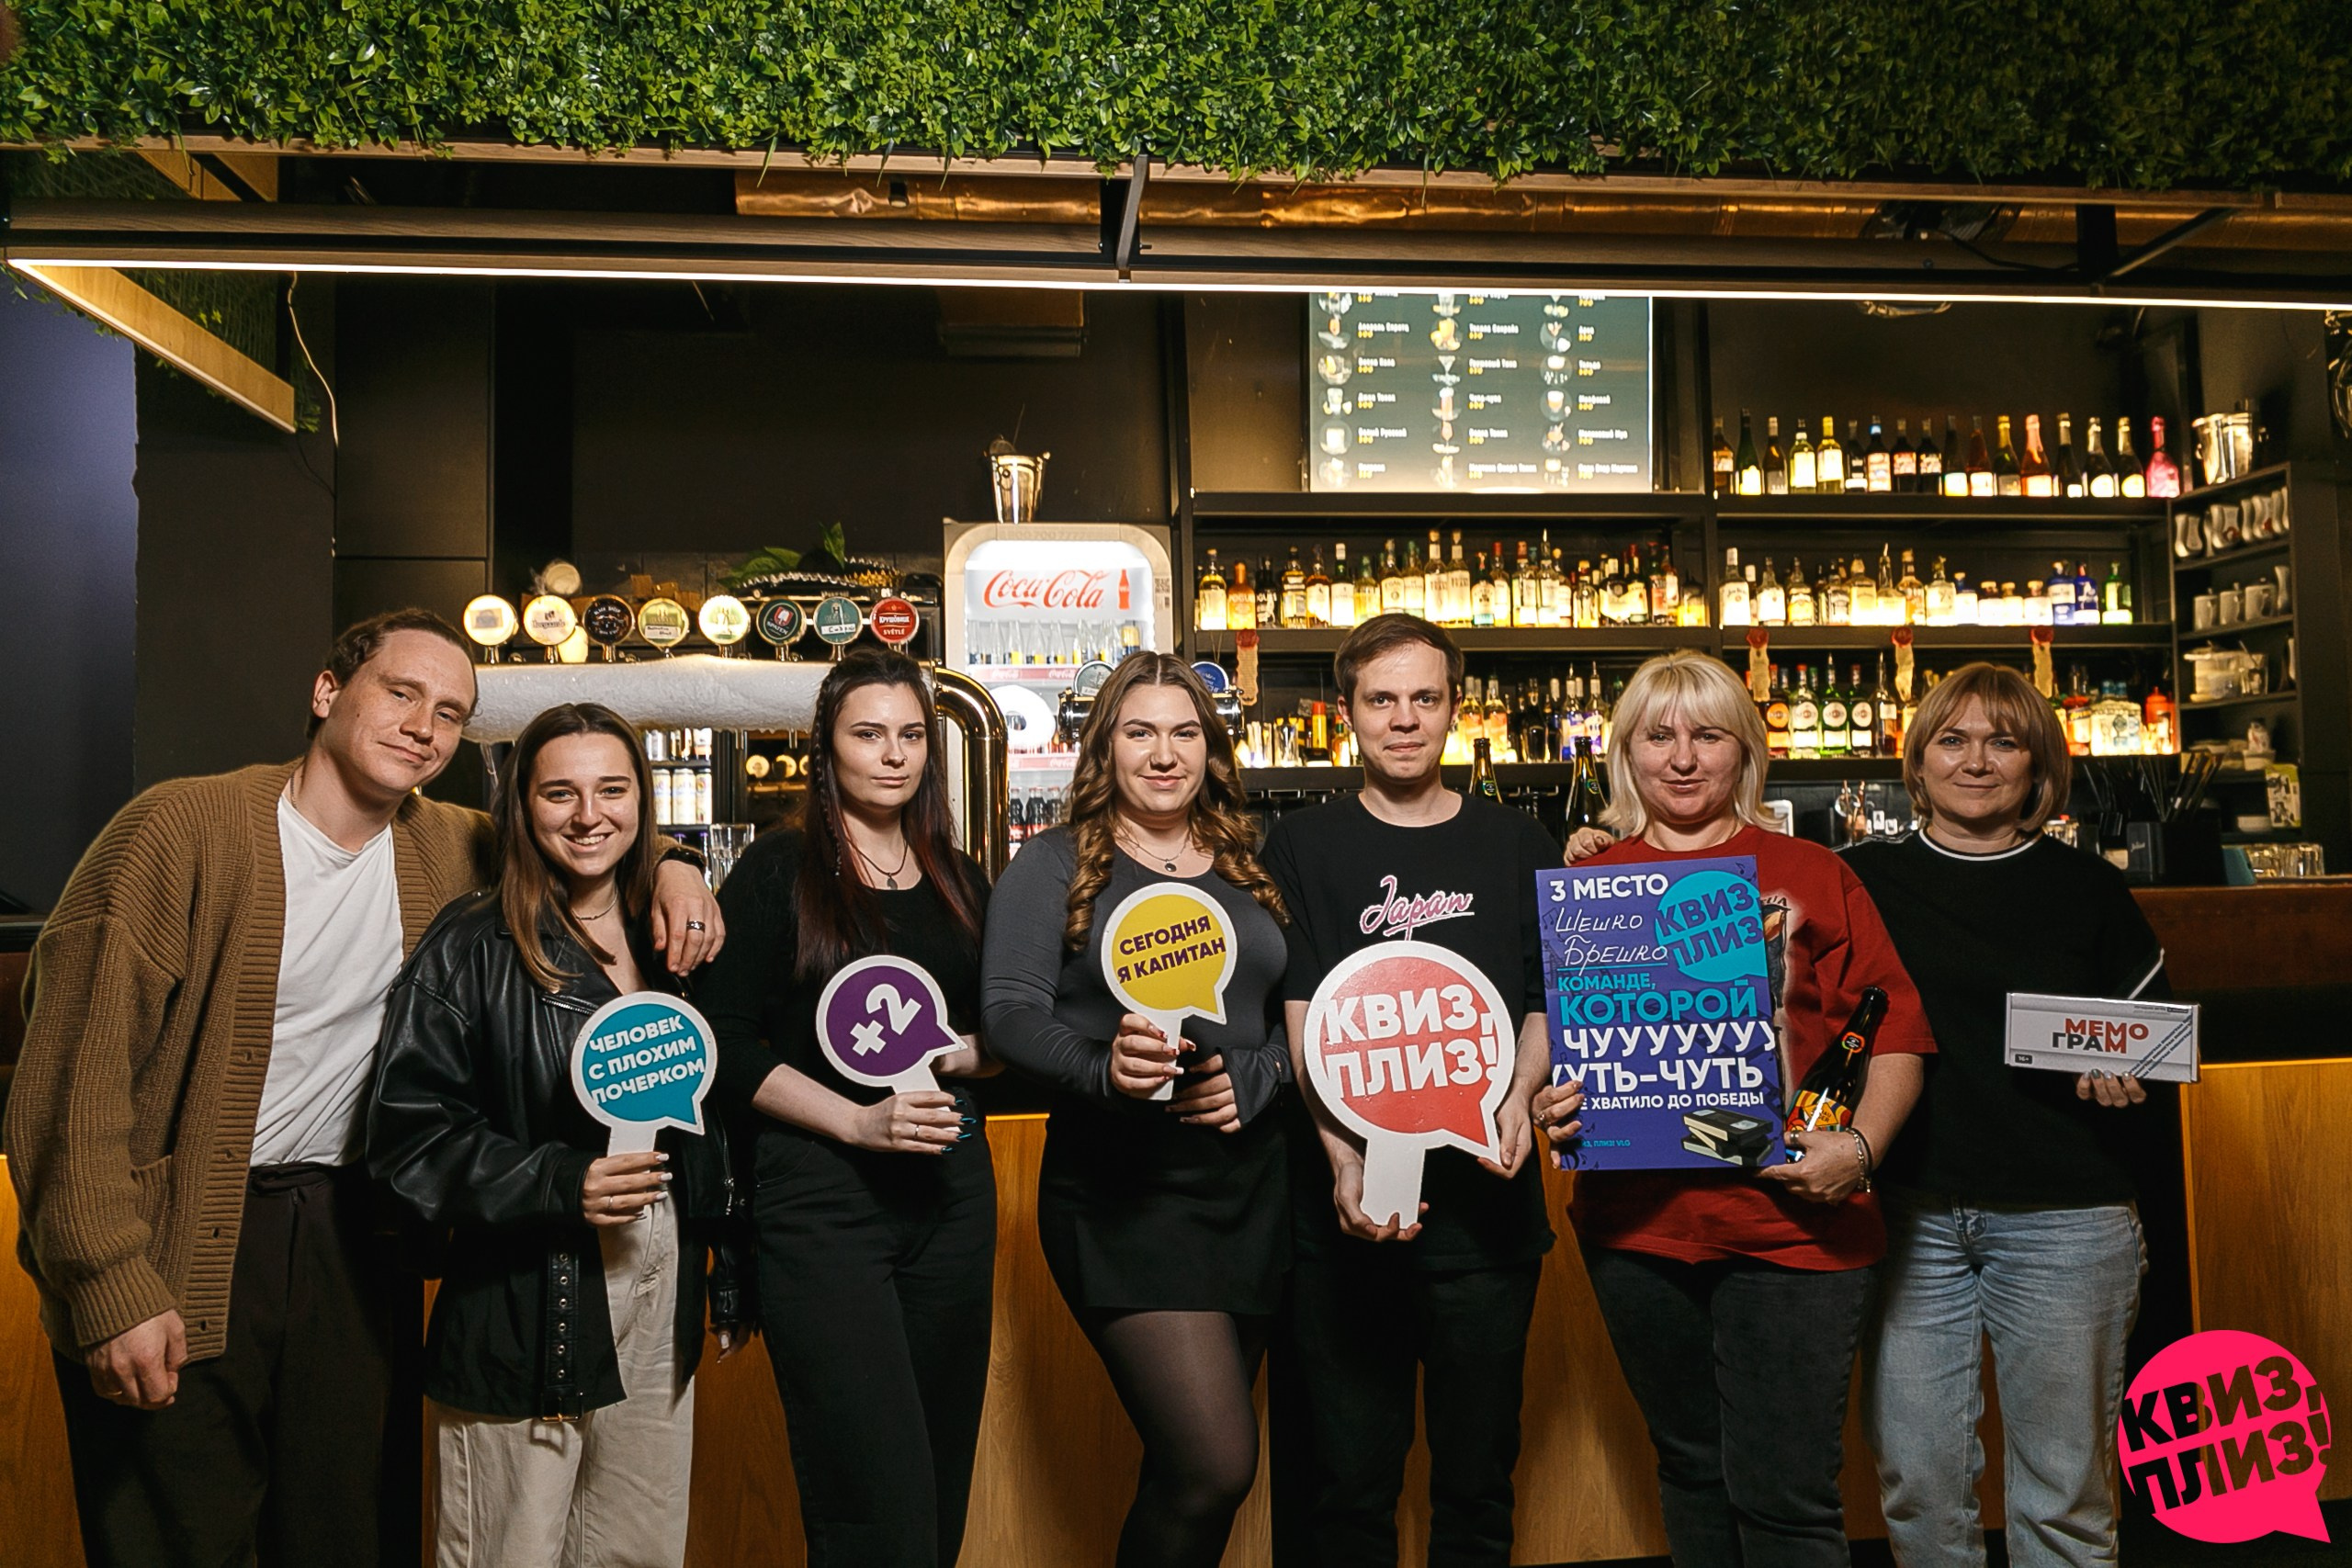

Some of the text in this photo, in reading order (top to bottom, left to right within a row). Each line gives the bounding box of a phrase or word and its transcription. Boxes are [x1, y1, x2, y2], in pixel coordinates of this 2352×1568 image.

[984, 570, 1110, 608] Coca-Cola
[1550, 873, 1669, 902] 3 МЕСТО
[1360, 874, 1475, 941] Japan
[1119, 915, 1212, 955] СЕГОДНЯ
[1116, 937, 1227, 984] Я КАПИТАН
[1557, 972, 1657, 992] КОМАНДЕ,
[1559, 979, 1758, 1027] КОТОРОЙ
[589, 1015, 684, 1054] ЧЕЛОВЕК
[2052, 1032, 2127, 1055] ГРАМ
[2064, 1018, 2150, 1041] МЕМО
[588, 1035, 697, 1080] С ПЛОХИМ
[590, 1058, 706, 1105] ПОЧЕРКОМ
[1591, 1094, 1664, 1111] ХВАТИЛО
[1667, 1094, 1692, 1110] ДО
[1695, 1091, 1764, 1108] ПОБЕДЫ
